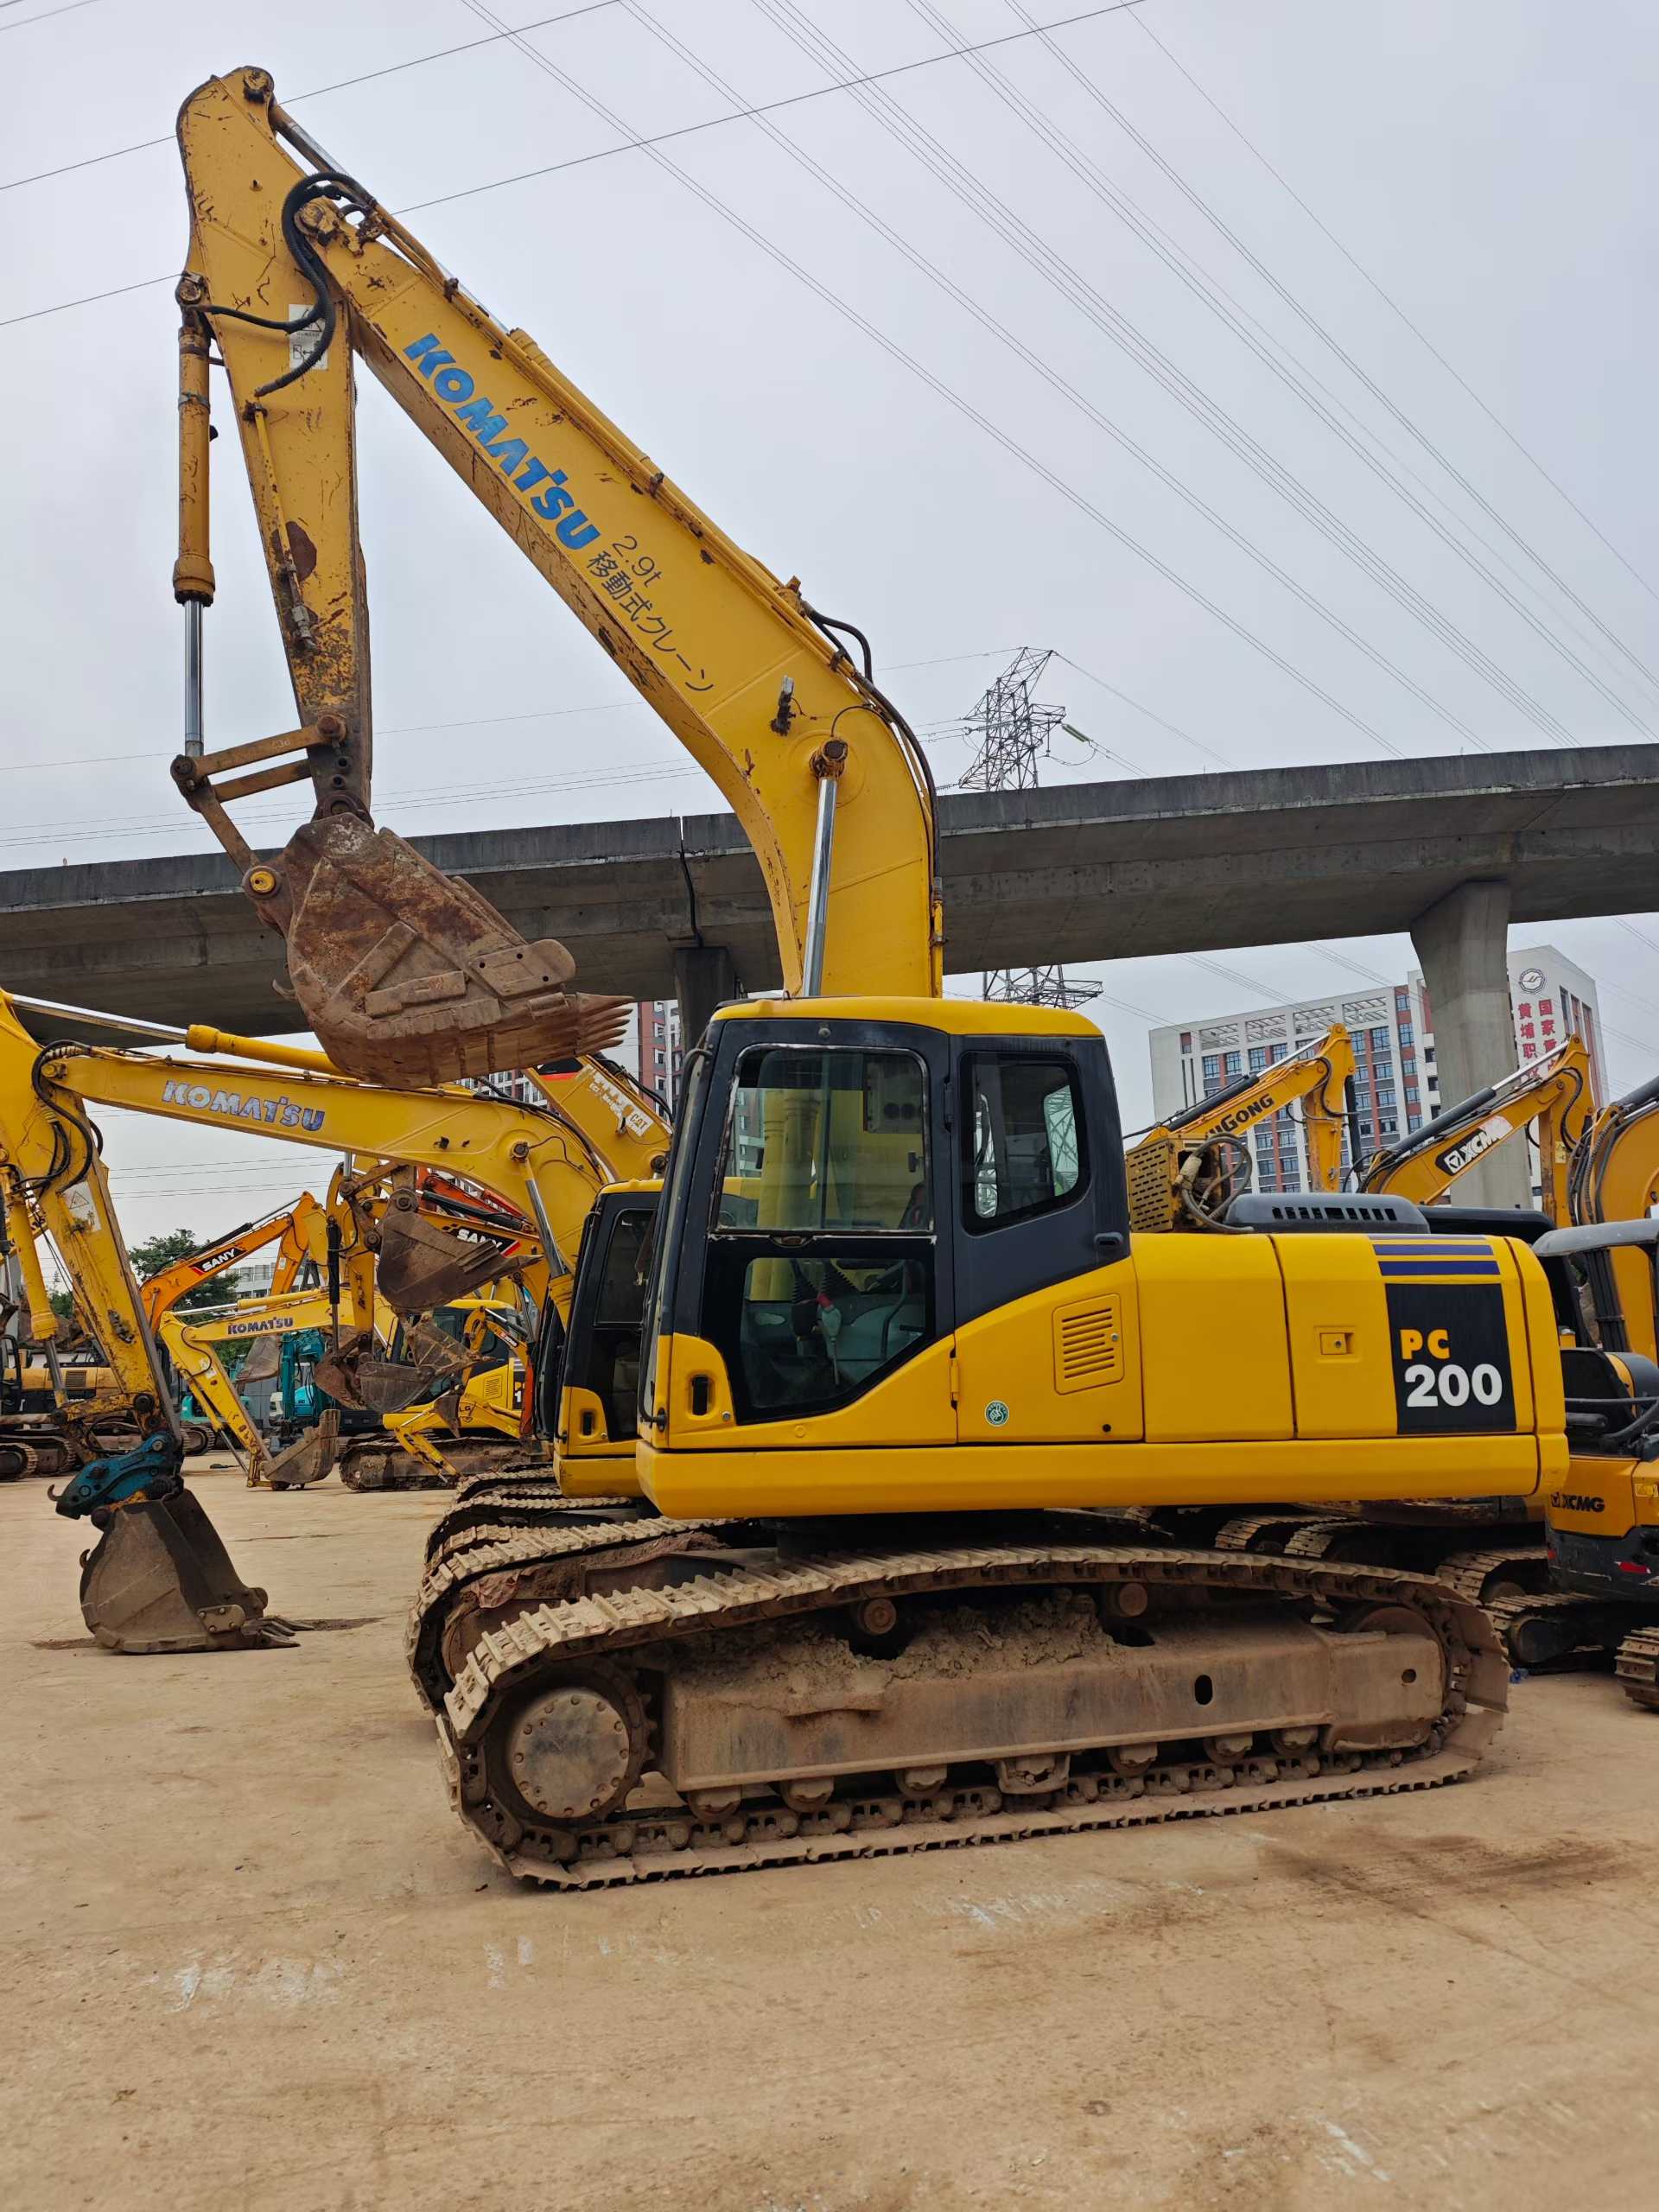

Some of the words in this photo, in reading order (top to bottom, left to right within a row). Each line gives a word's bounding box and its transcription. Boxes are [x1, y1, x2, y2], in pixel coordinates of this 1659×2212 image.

[403, 333, 601, 550] KOMATSU
[612, 536, 662, 588] 2.9t
[587, 550, 714, 690] 移動式クレーン
[162, 1080, 325, 1131] KOMATSU
[201, 1248, 235, 1272] SANY
[227, 1317, 294, 1335] KOMATSU
[1399, 1329, 1451, 1360] PC
[1404, 1363, 1503, 1408] 200
[1561, 1493, 1605, 1513] XCMG
